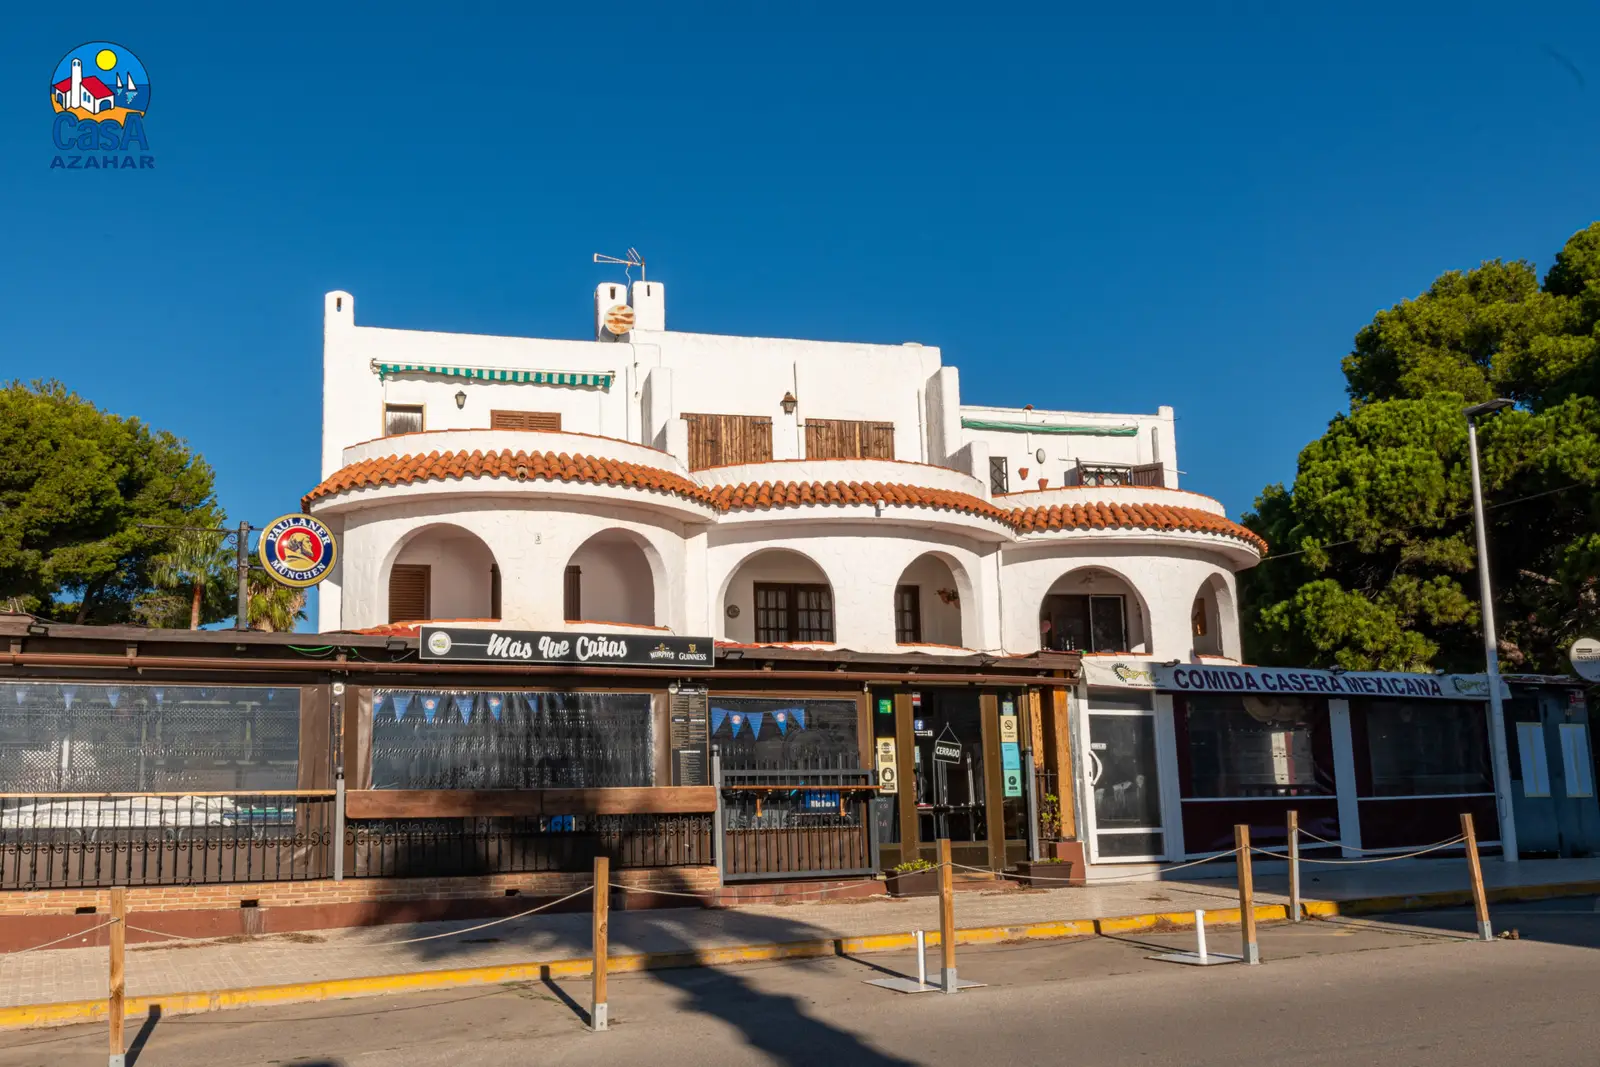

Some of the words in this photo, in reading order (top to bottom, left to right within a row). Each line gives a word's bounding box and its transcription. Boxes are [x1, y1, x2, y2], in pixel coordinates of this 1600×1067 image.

[267, 518, 331, 546] PAULANER
[576, 635, 628, 662] Cañas
[678, 652, 707, 661] GUINNESS
[1173, 668, 1262, 690] COMIDA
[1261, 672, 1346, 693] CASERA
[1342, 675, 1443, 697] MEXICANA
[936, 746, 960, 758] CERRADO
